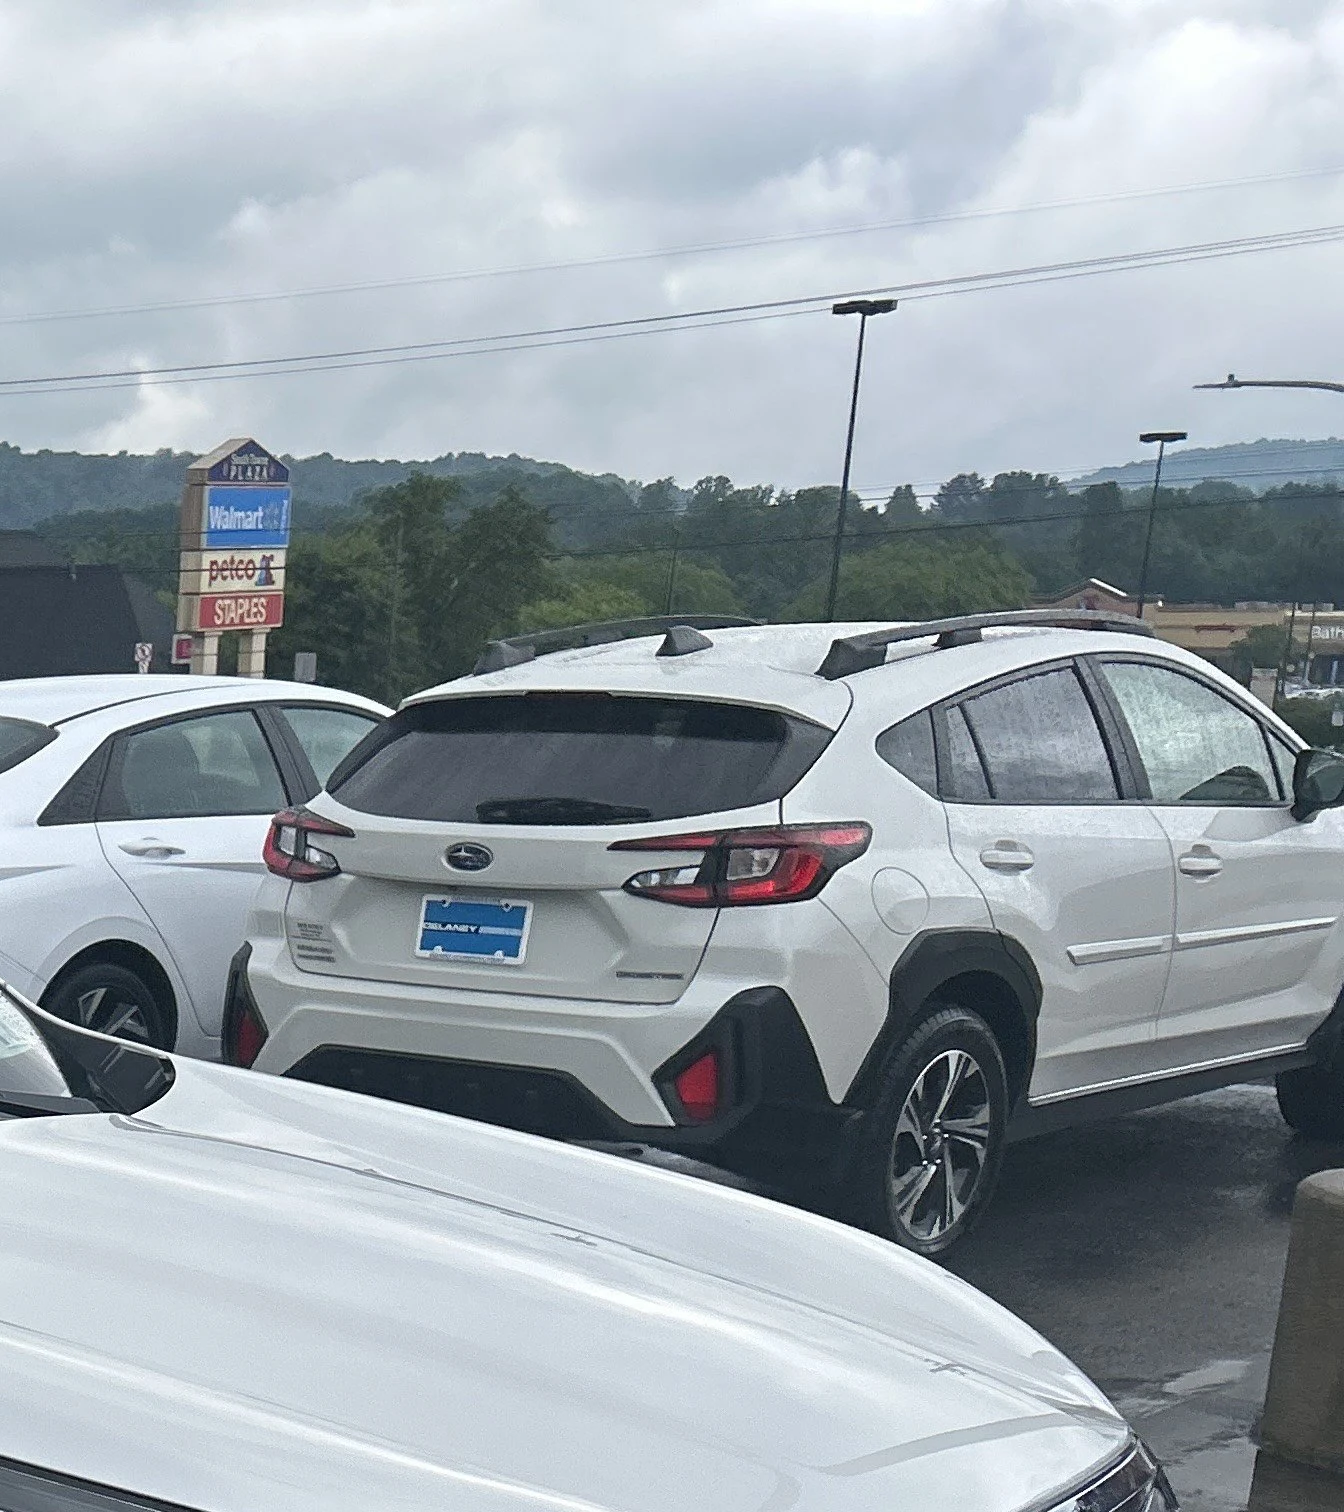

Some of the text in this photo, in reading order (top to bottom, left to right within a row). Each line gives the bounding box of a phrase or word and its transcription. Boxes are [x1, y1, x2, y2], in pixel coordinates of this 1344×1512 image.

[229, 465, 268, 481] PLAZA
[209, 506, 263, 530] Walmart
[208, 555, 256, 588] petco
[214, 597, 267, 625] STAPLES
[423, 921, 477, 933] DELANEY
